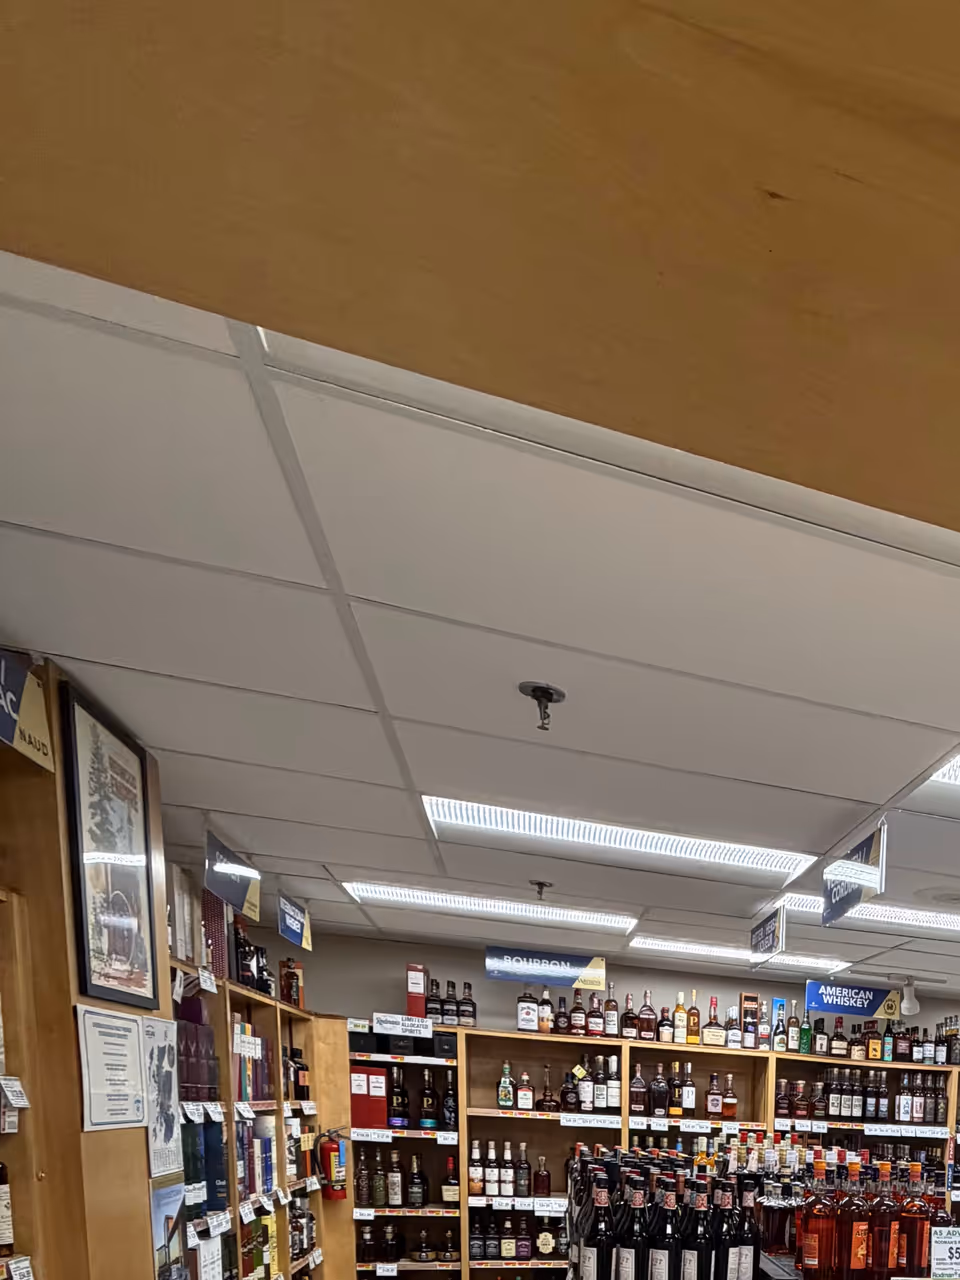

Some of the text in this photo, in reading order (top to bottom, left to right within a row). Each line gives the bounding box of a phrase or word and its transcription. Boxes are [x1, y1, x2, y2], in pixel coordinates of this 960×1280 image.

[503, 955, 571, 970] BOURBON
[819, 985, 873, 1000] AMERICAN
[822, 995, 869, 1008] WHISKEY
[401, 1022, 429, 1030] ALLOCATED
